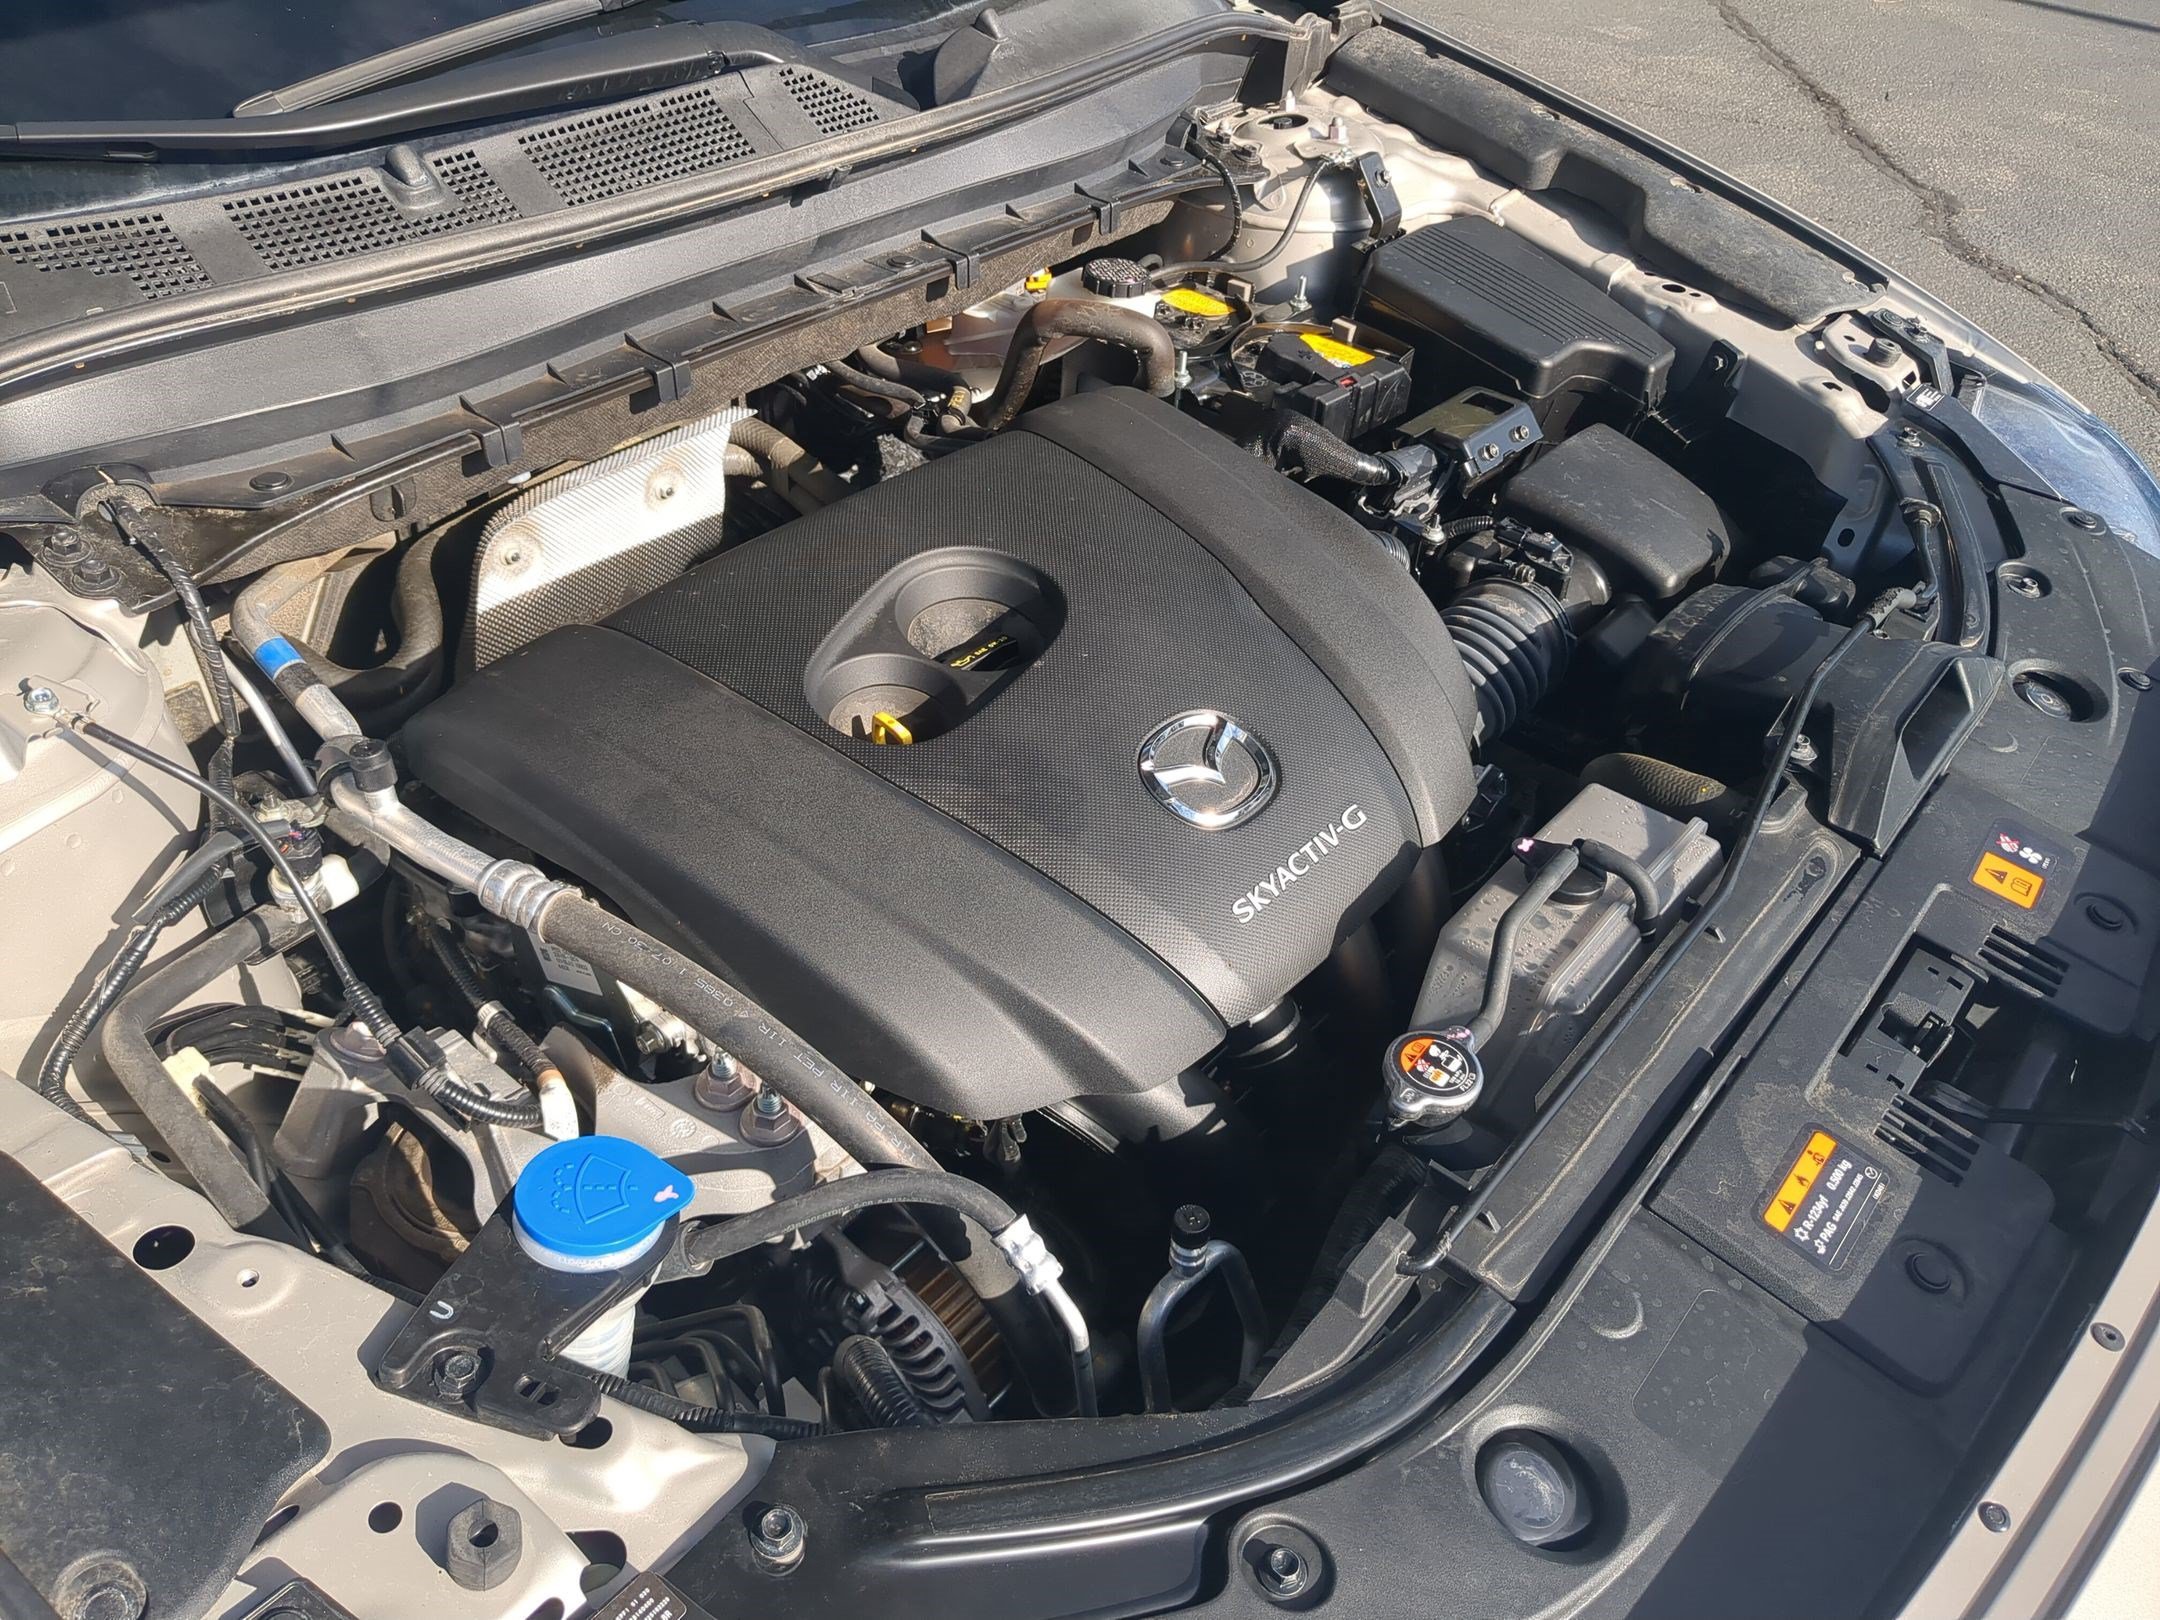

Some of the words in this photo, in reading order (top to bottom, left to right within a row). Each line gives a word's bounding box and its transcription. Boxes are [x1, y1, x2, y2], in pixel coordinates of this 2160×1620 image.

[1231, 804, 1368, 924] SKYACTIV-G
[792, 1052, 825, 1077] PET
[1802, 1194, 1830, 1231] R-1234yf
[1826, 1168, 1844, 1191] 0.500
[1837, 1159, 1853, 1172] kg
[1820, 1221, 1838, 1243] PAG
